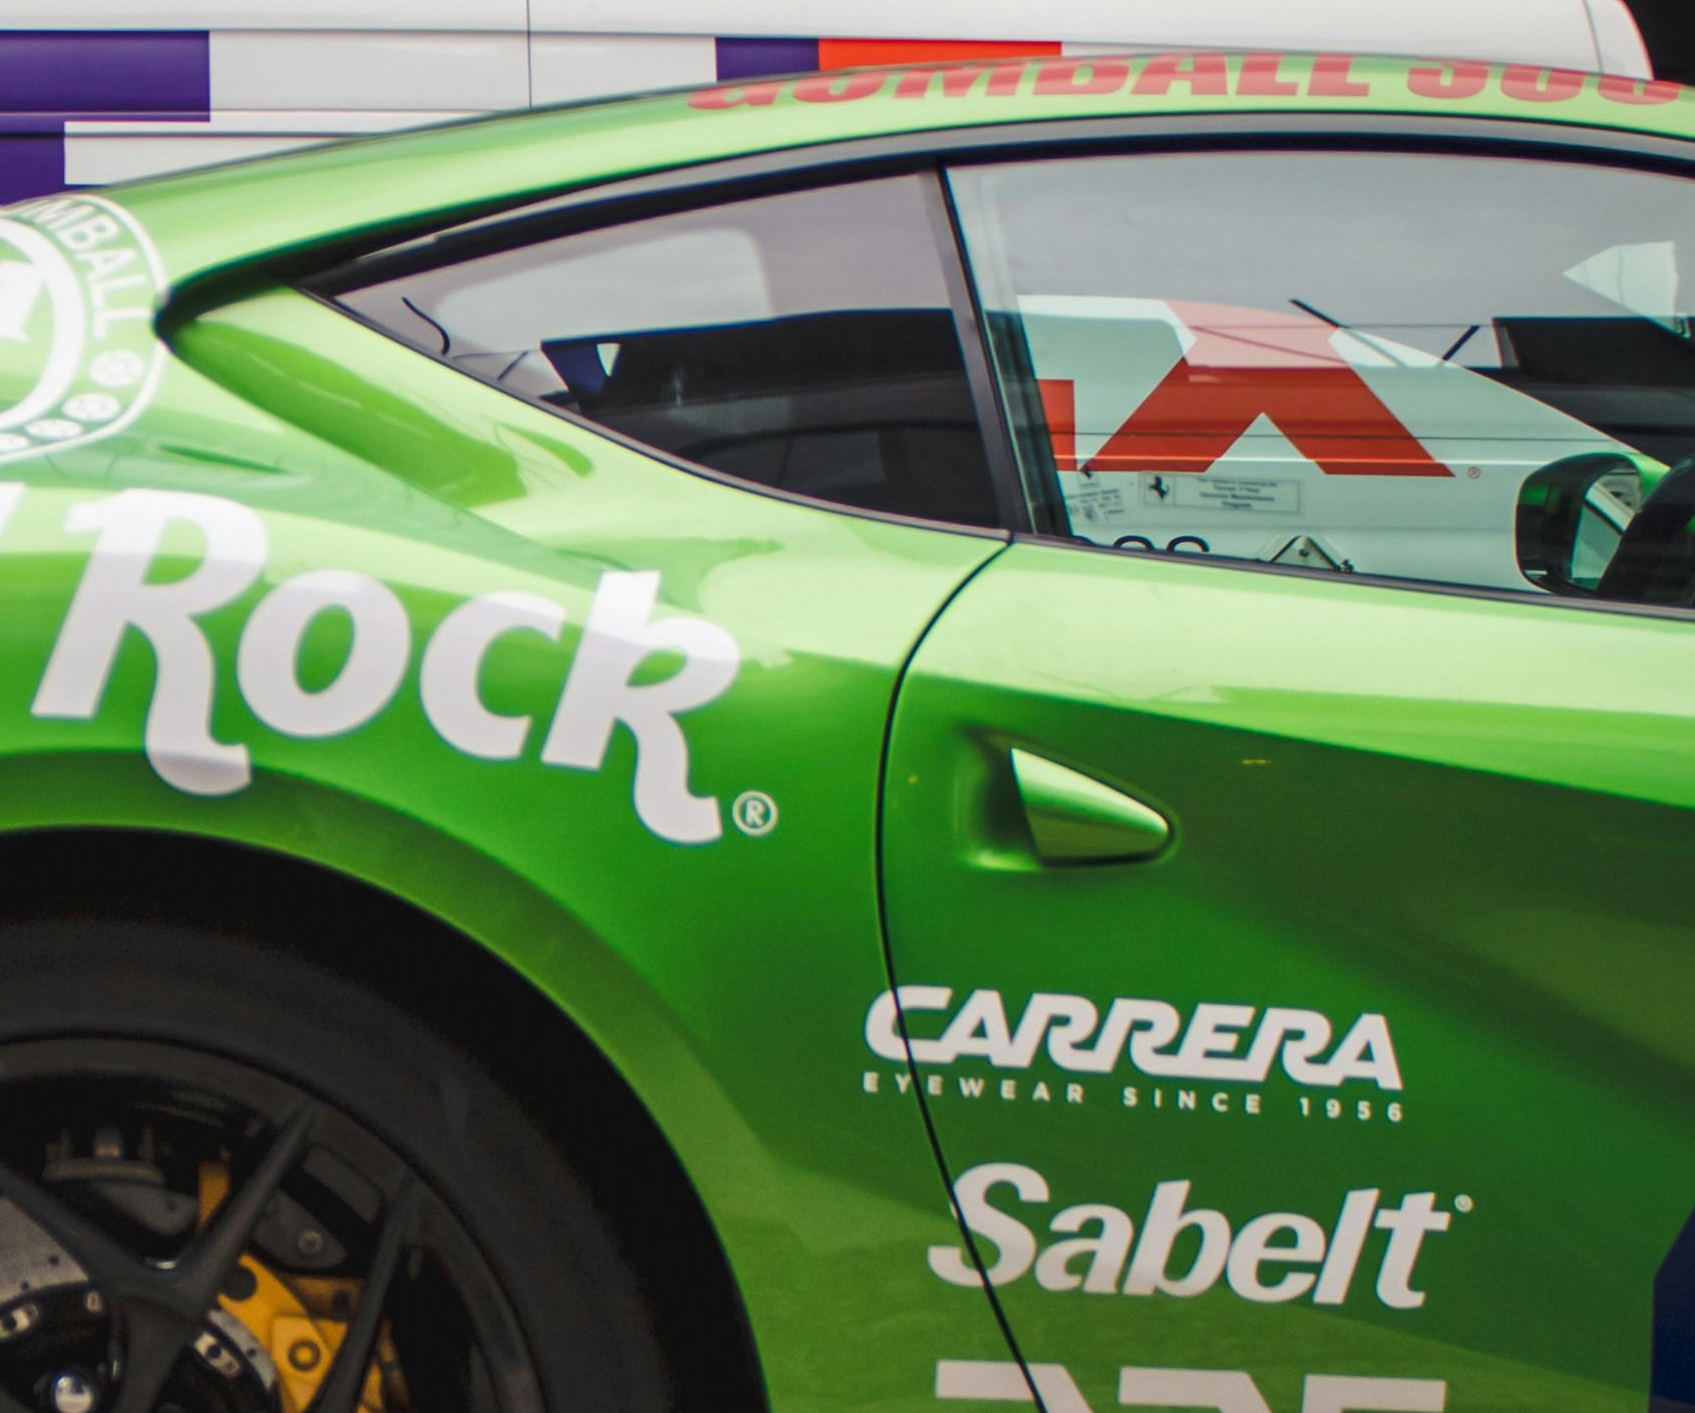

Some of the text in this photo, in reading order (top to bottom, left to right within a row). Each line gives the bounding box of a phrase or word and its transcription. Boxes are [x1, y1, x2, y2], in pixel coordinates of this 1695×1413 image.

[30, 487, 744, 845] Rock
[863, 1071, 1403, 1123] EYEWEAR SINCE 1956
[864, 985, 1403, 1090] CARRERA
[927, 1162, 1451, 1309] Sabelt
